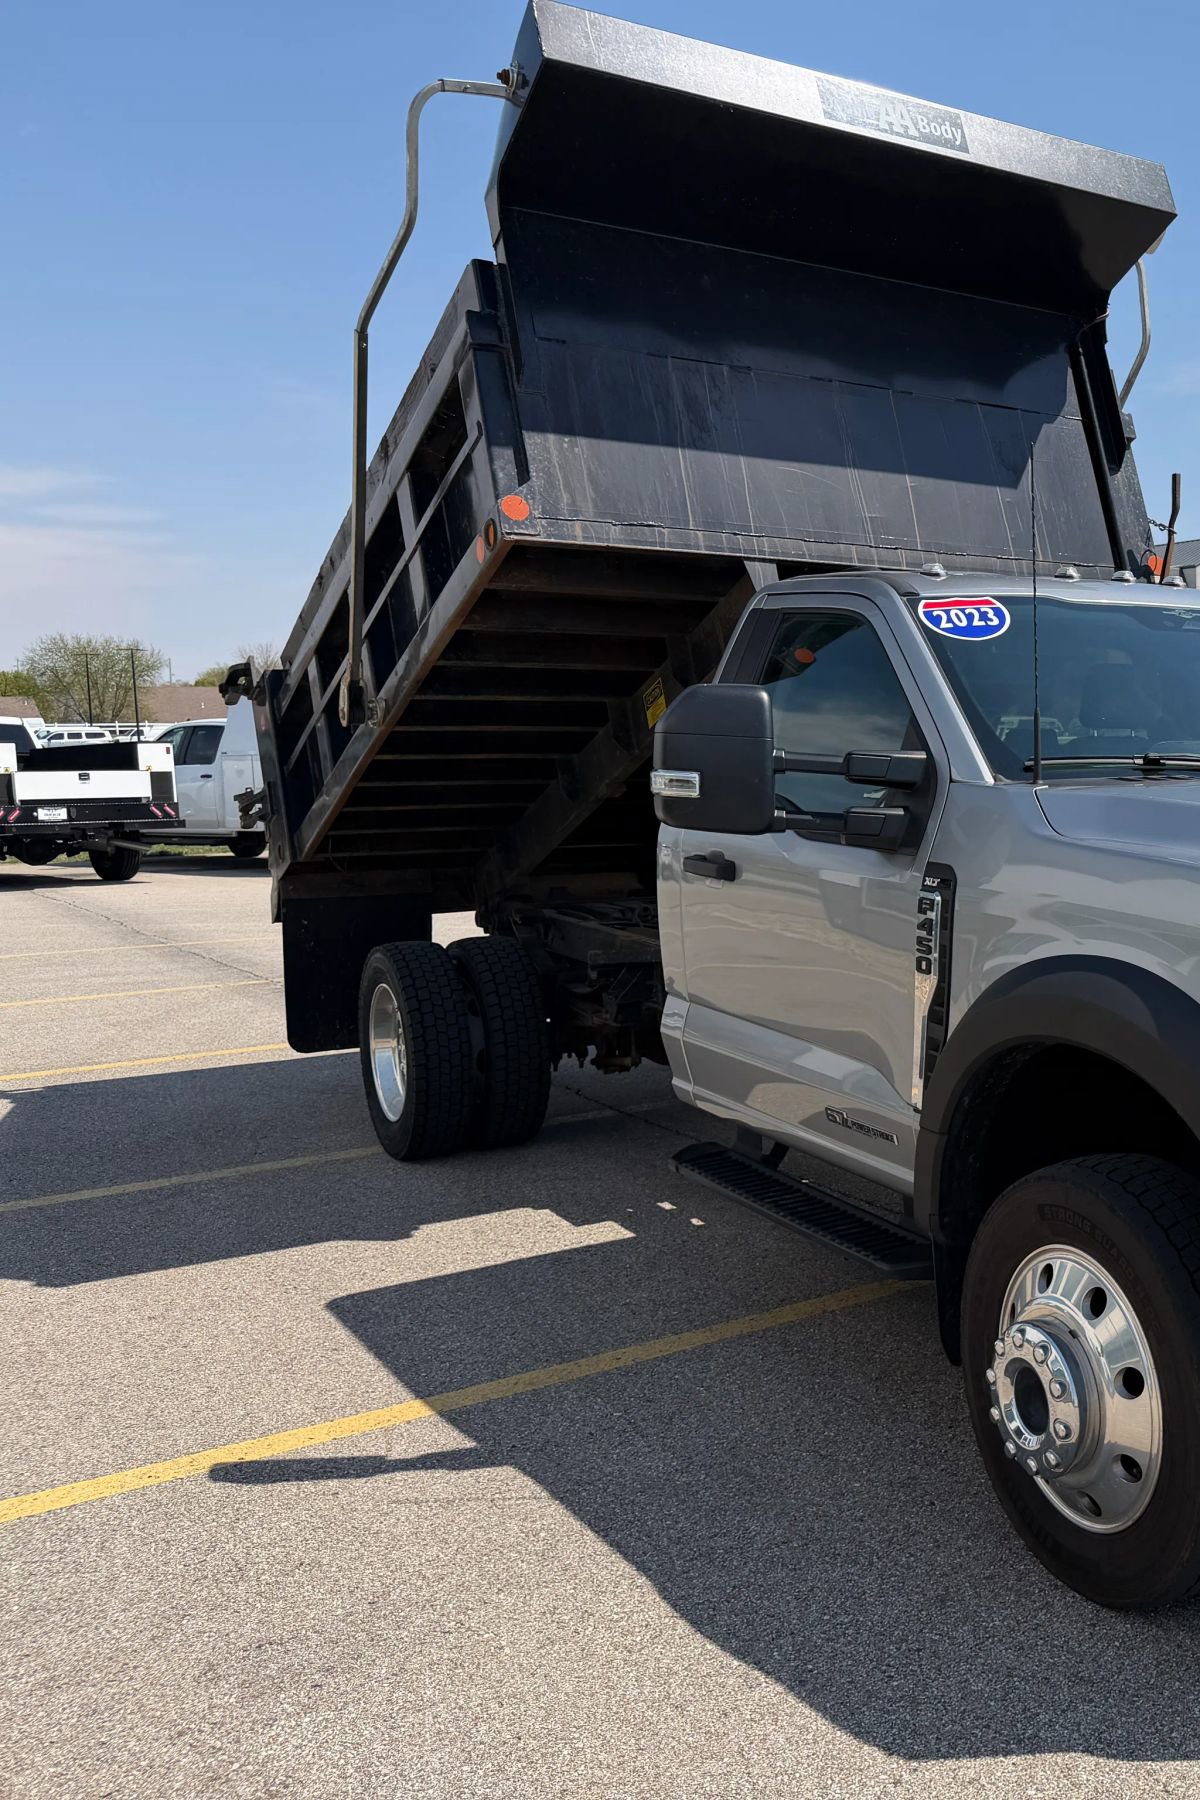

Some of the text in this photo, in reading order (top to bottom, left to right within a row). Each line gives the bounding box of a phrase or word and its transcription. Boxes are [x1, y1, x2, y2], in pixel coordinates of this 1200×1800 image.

[916, 115, 962, 145] Body
[932, 607, 999, 628] 2023
[923, 876, 940, 887] XLT
[915, 896, 936, 976] F450
[1043, 1205, 1093, 1233] STRONG
